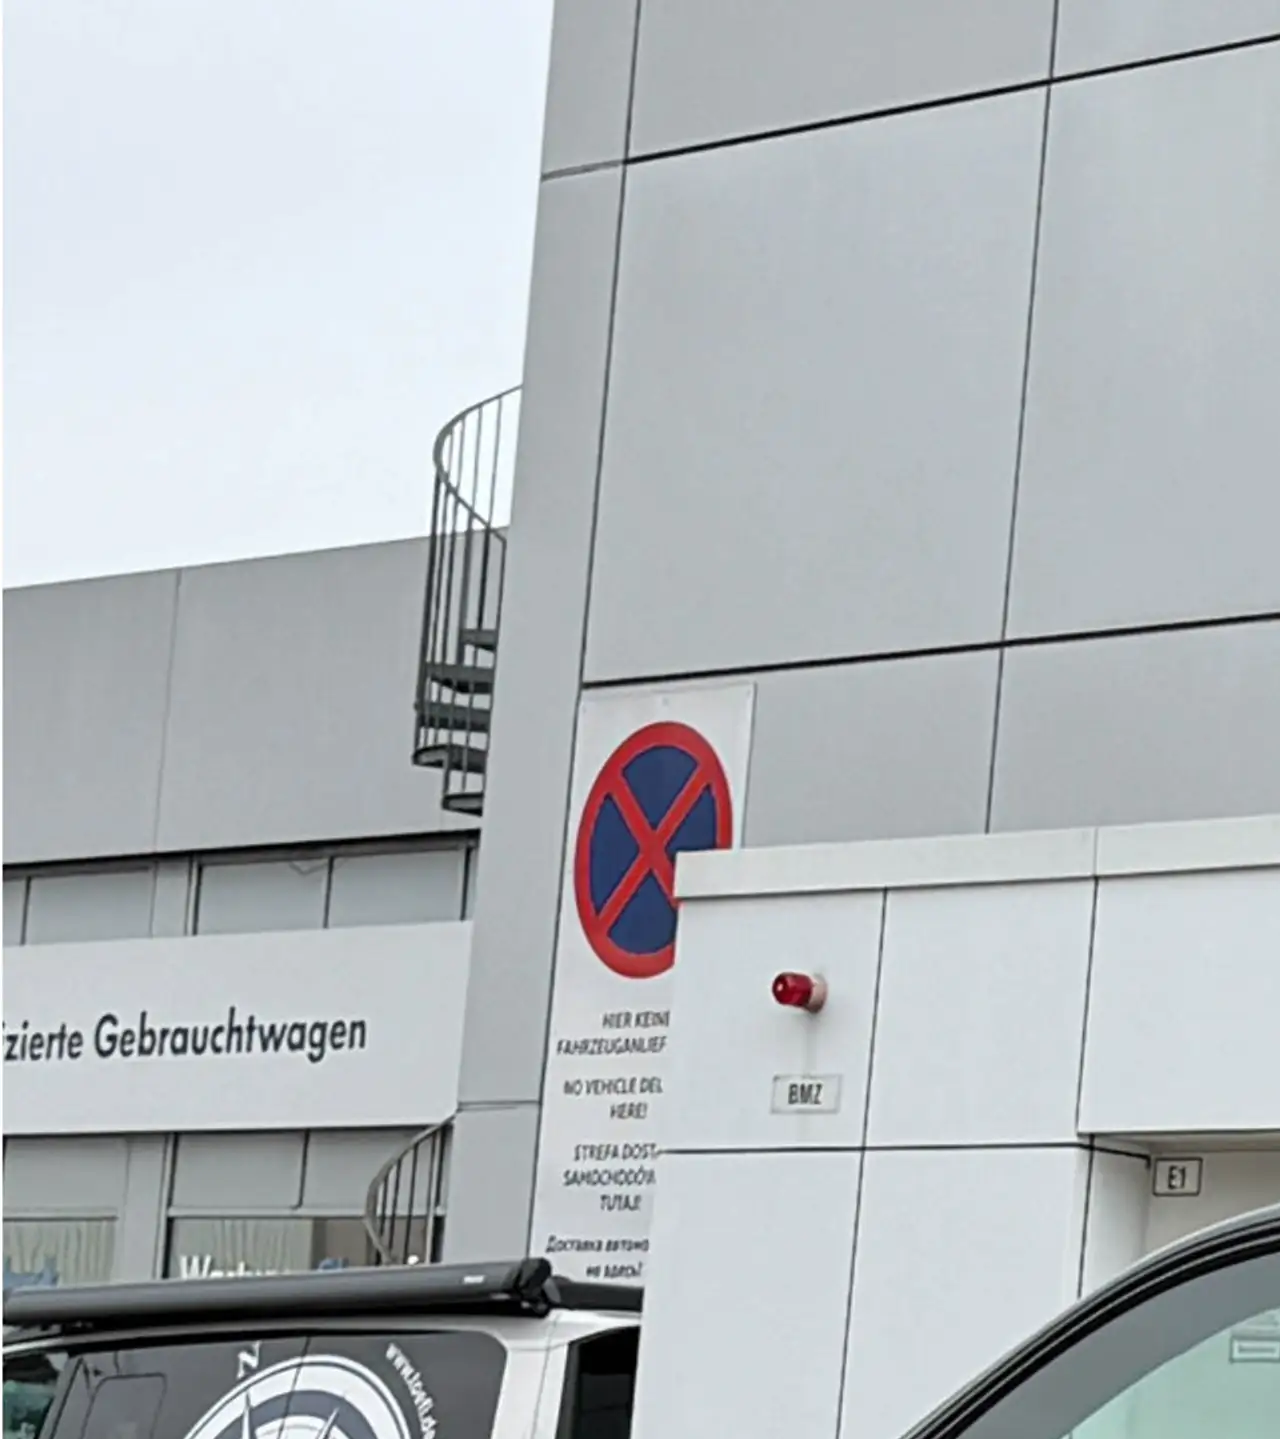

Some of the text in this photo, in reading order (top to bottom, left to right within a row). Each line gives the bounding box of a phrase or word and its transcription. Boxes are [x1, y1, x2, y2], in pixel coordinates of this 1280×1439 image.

[602, 1012, 633, 1029] HIER
[94, 1006, 367, 1064] Gebrauchtwagen
[563, 1080, 583, 1097] NO
[585, 1077, 637, 1096] VEHICLE
[788, 1083, 823, 1105] BMZ
[610, 1102, 648, 1120] HERE!
[1168, 1165, 1186, 1190] E1
